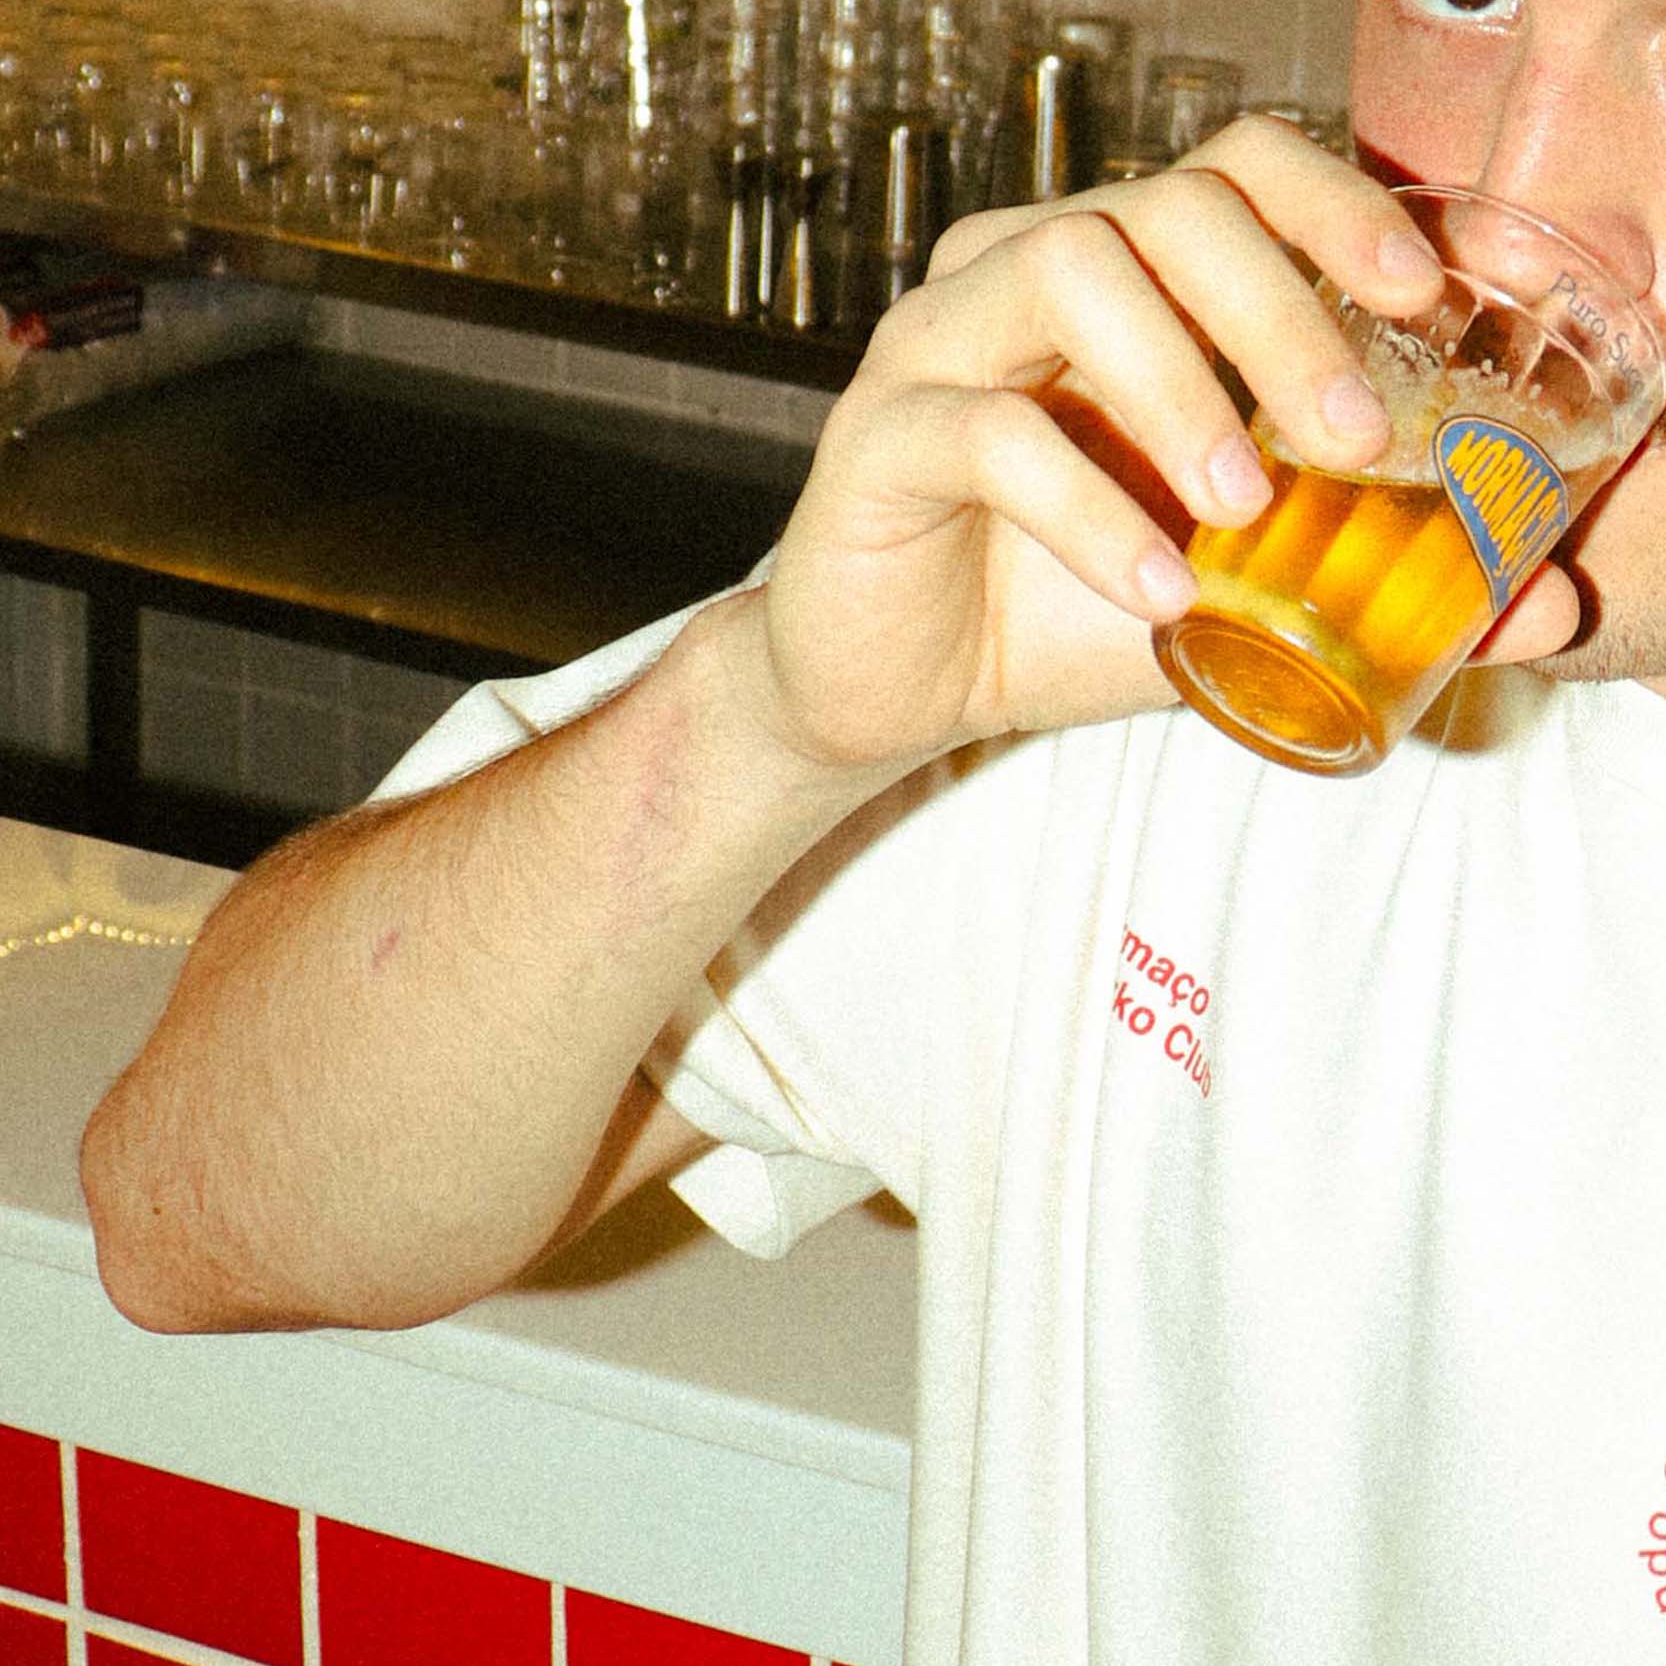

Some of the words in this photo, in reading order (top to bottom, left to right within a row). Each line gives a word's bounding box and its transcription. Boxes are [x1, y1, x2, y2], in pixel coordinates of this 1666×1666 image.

[1120, 923, 1211, 1016] maço
[1111, 981, 1157, 1036] ko
[1163, 1023, 1212, 1099] Club
